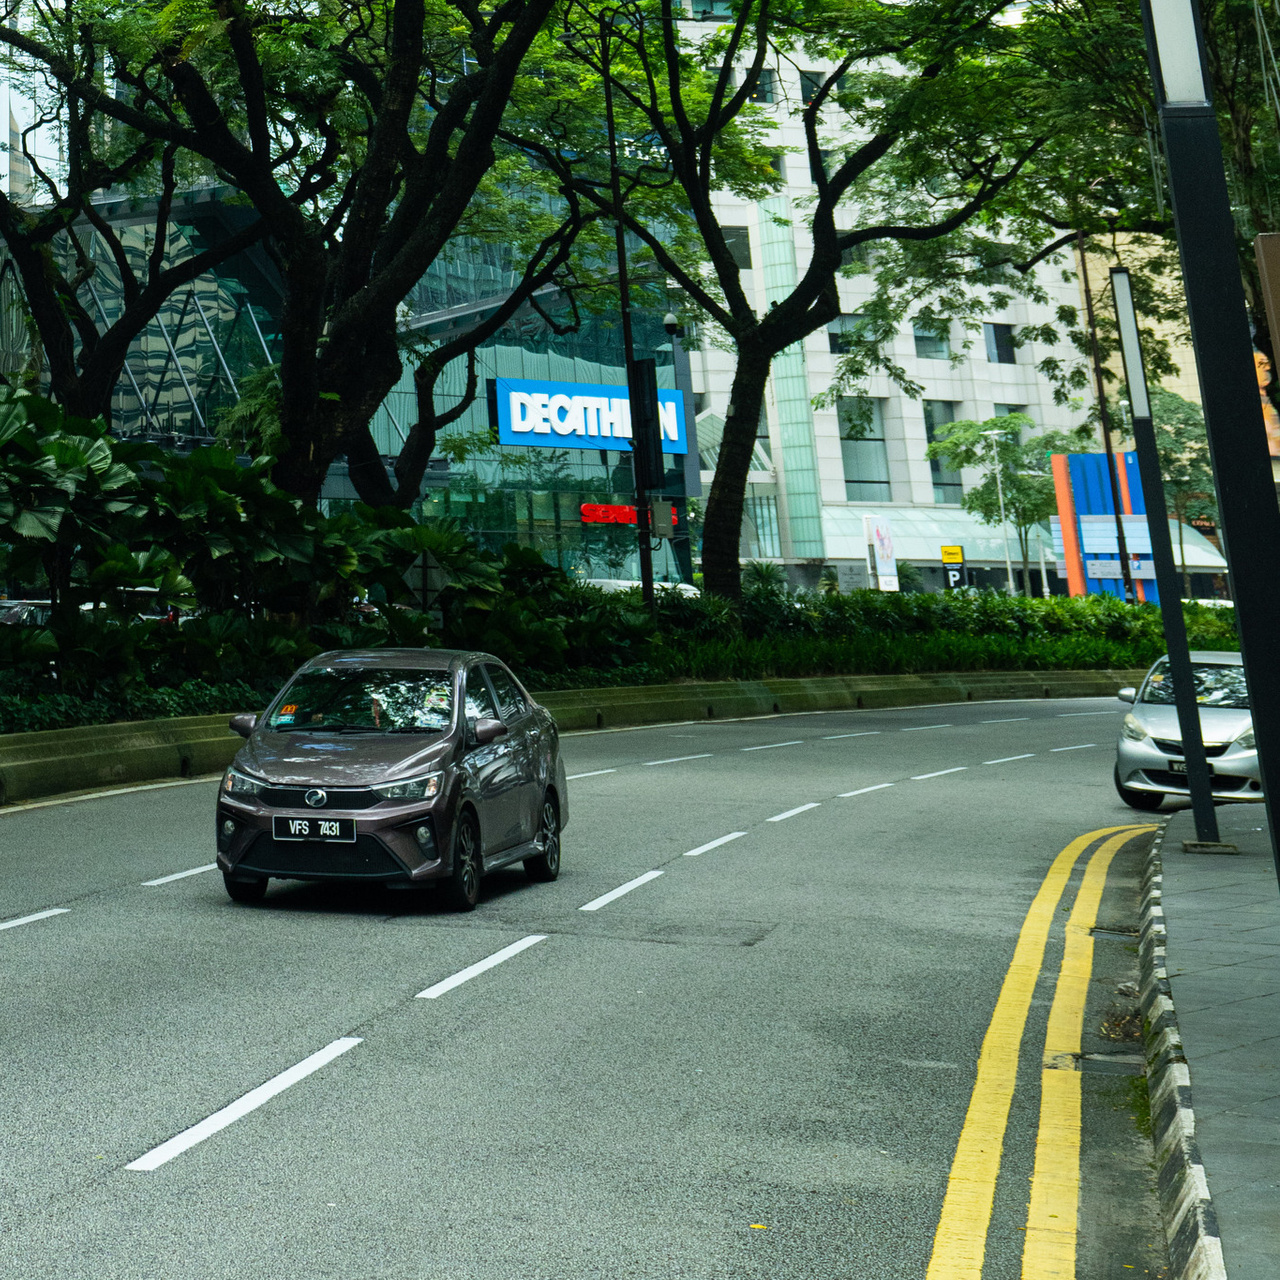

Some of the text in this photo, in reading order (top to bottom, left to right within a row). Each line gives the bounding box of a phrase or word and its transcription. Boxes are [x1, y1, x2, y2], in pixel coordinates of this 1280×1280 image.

[509, 391, 678, 441] DECATHLN
[948, 570, 960, 587] P
[289, 820, 340, 836] VFS 7431
